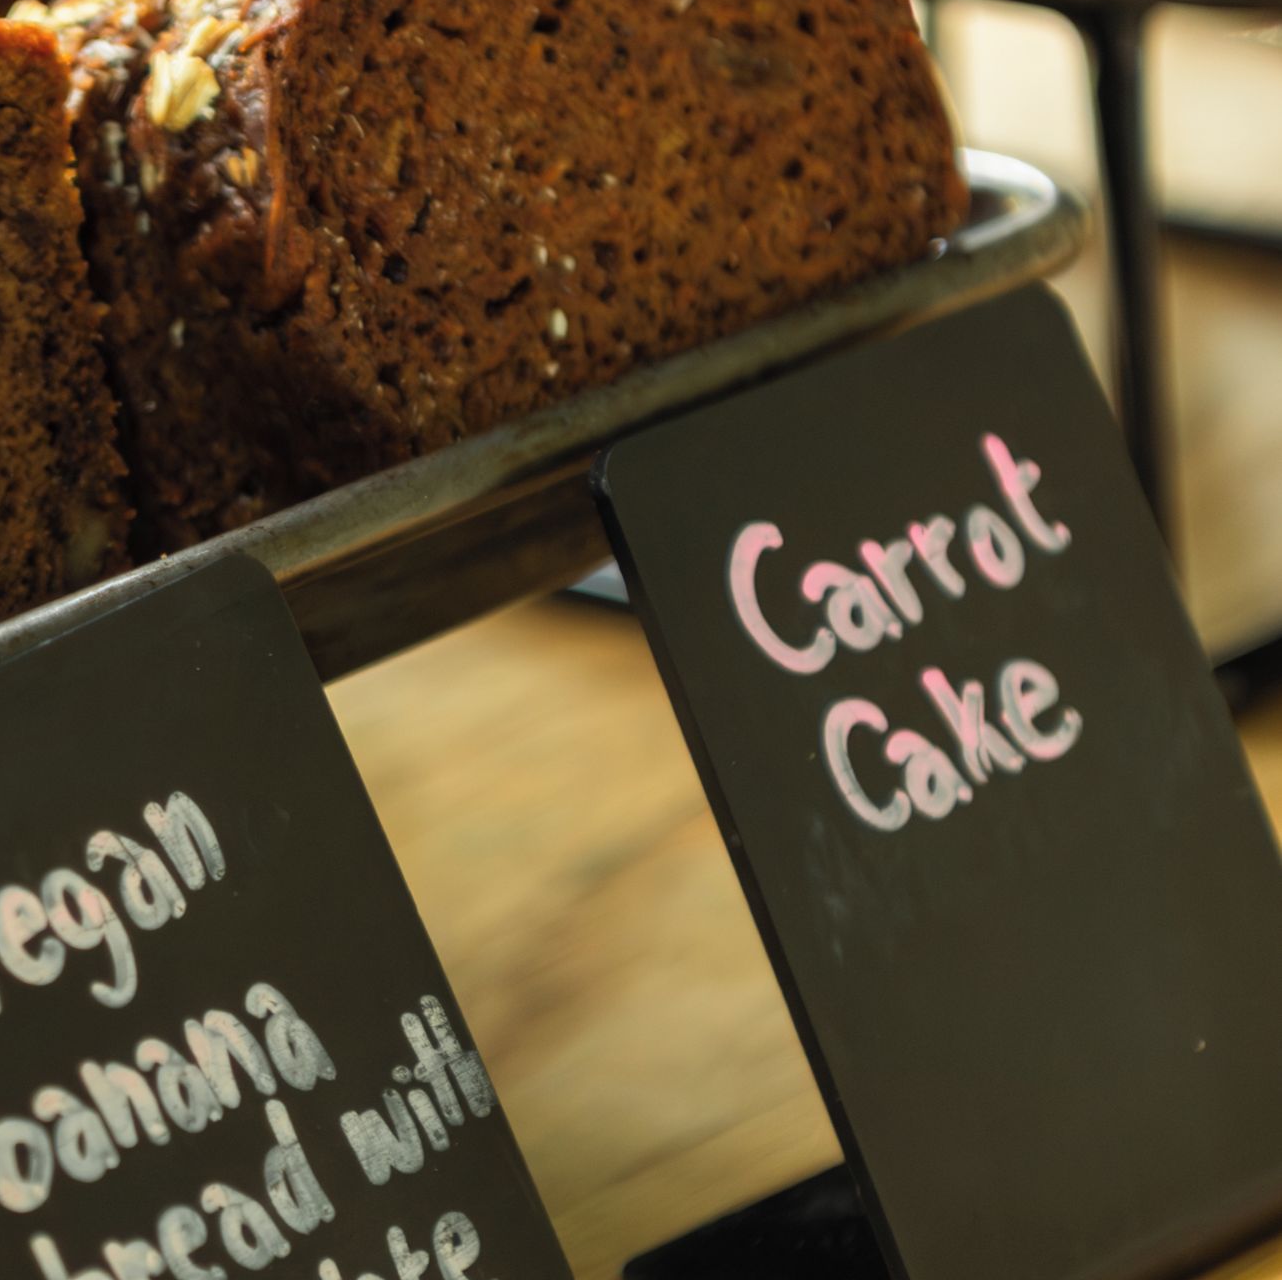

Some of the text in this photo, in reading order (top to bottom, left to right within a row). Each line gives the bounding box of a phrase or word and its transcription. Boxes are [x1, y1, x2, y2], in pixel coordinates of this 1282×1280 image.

[728, 431, 1072, 674] Carrot
[822, 658, 1083, 832] Cake
[340, 994, 495, 1185] with
